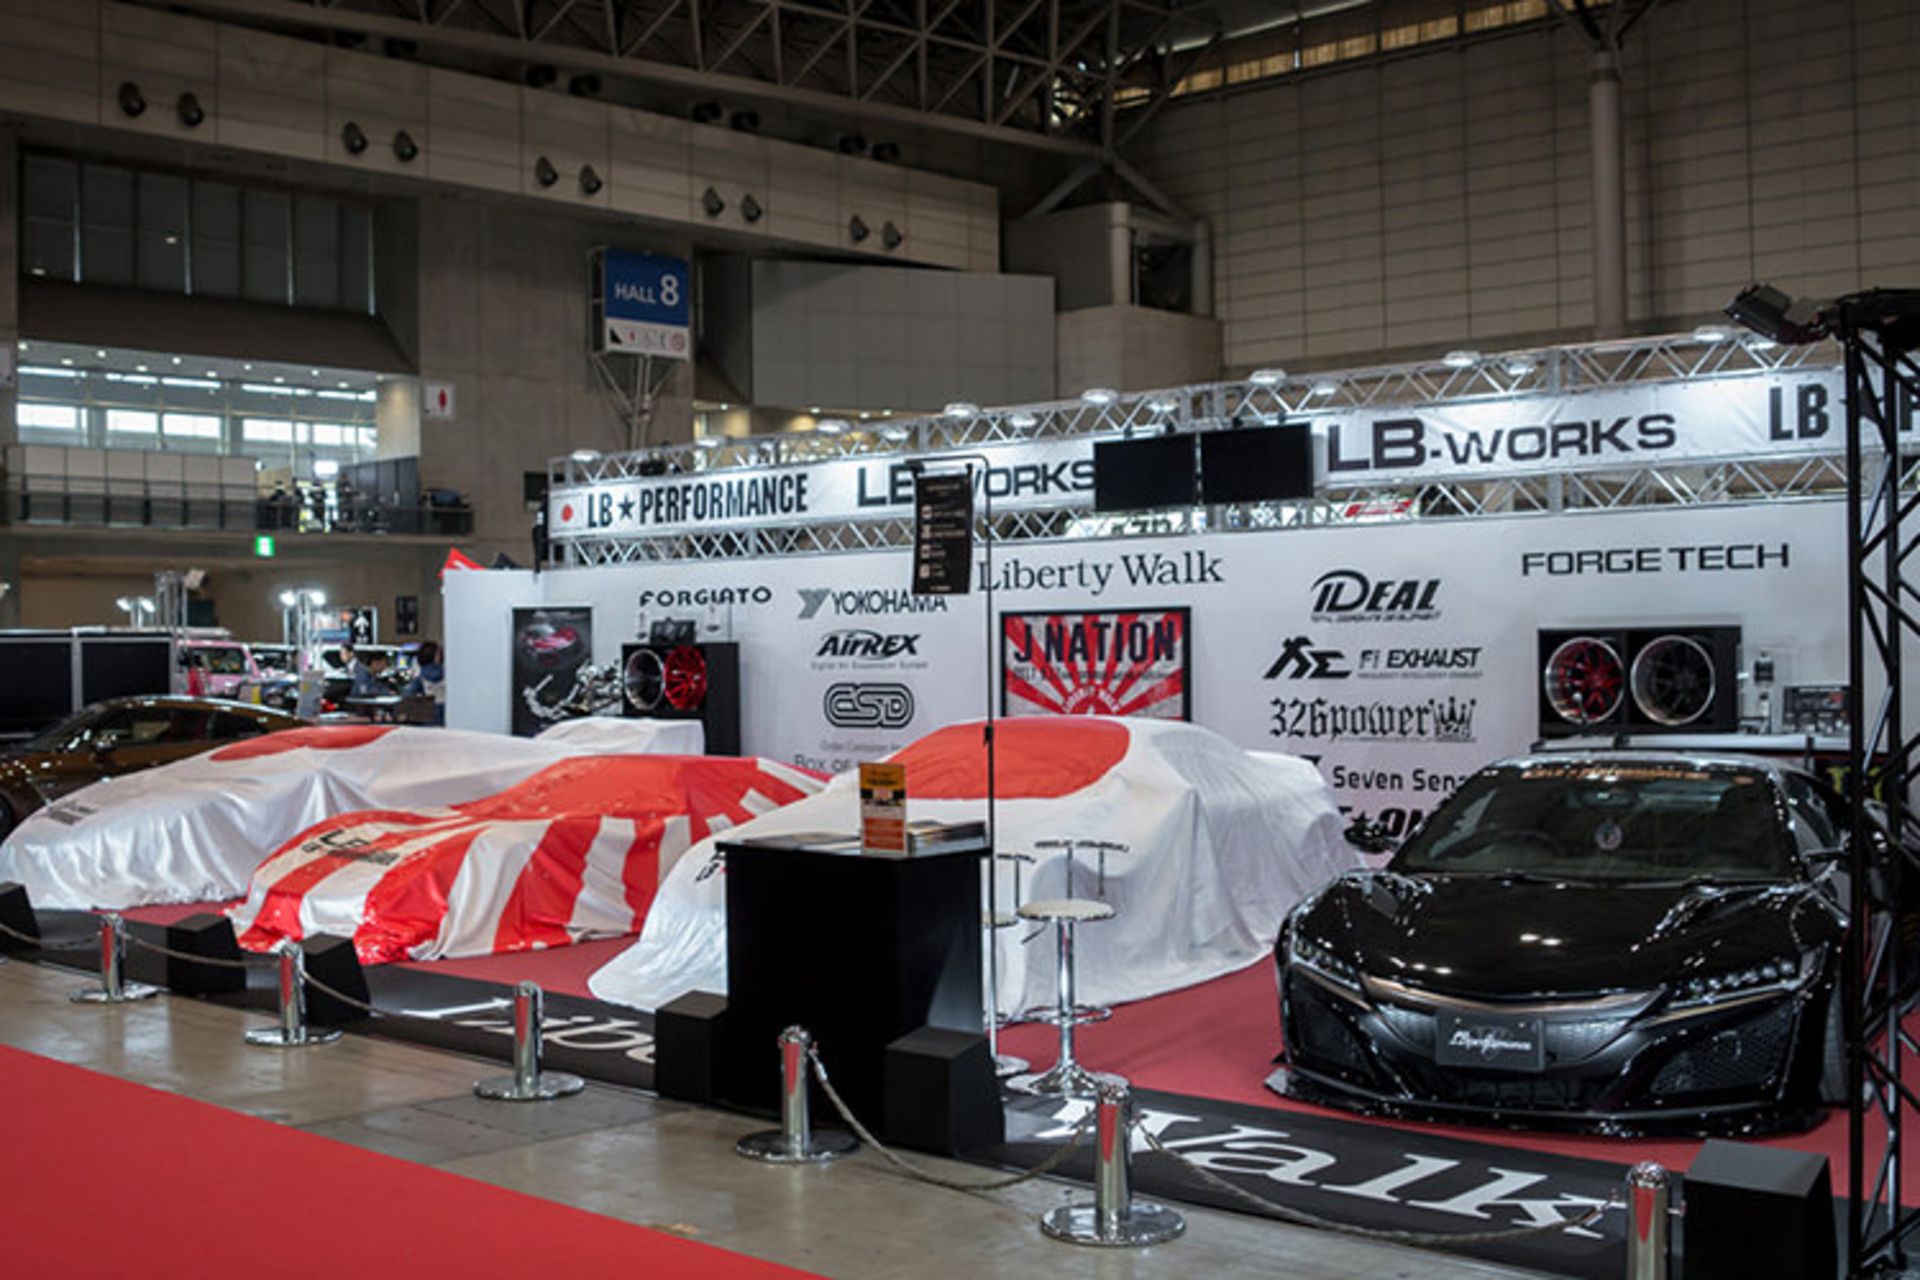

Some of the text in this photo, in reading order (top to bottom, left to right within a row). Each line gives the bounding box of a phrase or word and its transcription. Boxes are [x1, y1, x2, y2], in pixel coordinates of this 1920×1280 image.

[614, 273, 680, 306] HALL 8
[1769, 383, 1829, 440] LB
[1328, 414, 1677, 473] LB-WORKS
[588, 473, 808, 528] LB PERFORMANCE
[977, 558, 1112, 595] Liberty
[1121, 550, 1224, 585] Walk
[1522, 543, 1789, 576] FORGE TECH
[639, 586, 772, 606] FORGIATO
[831, 589, 947, 615] YOKOHAMA
[1013, 621, 1176, 662] J NATION
[1387, 647, 1482, 669] EXHAUST
[1270, 697, 1431, 743] 326power
[1333, 766, 1404, 790] Seven
[1034, 1098, 1628, 1239] Walk
